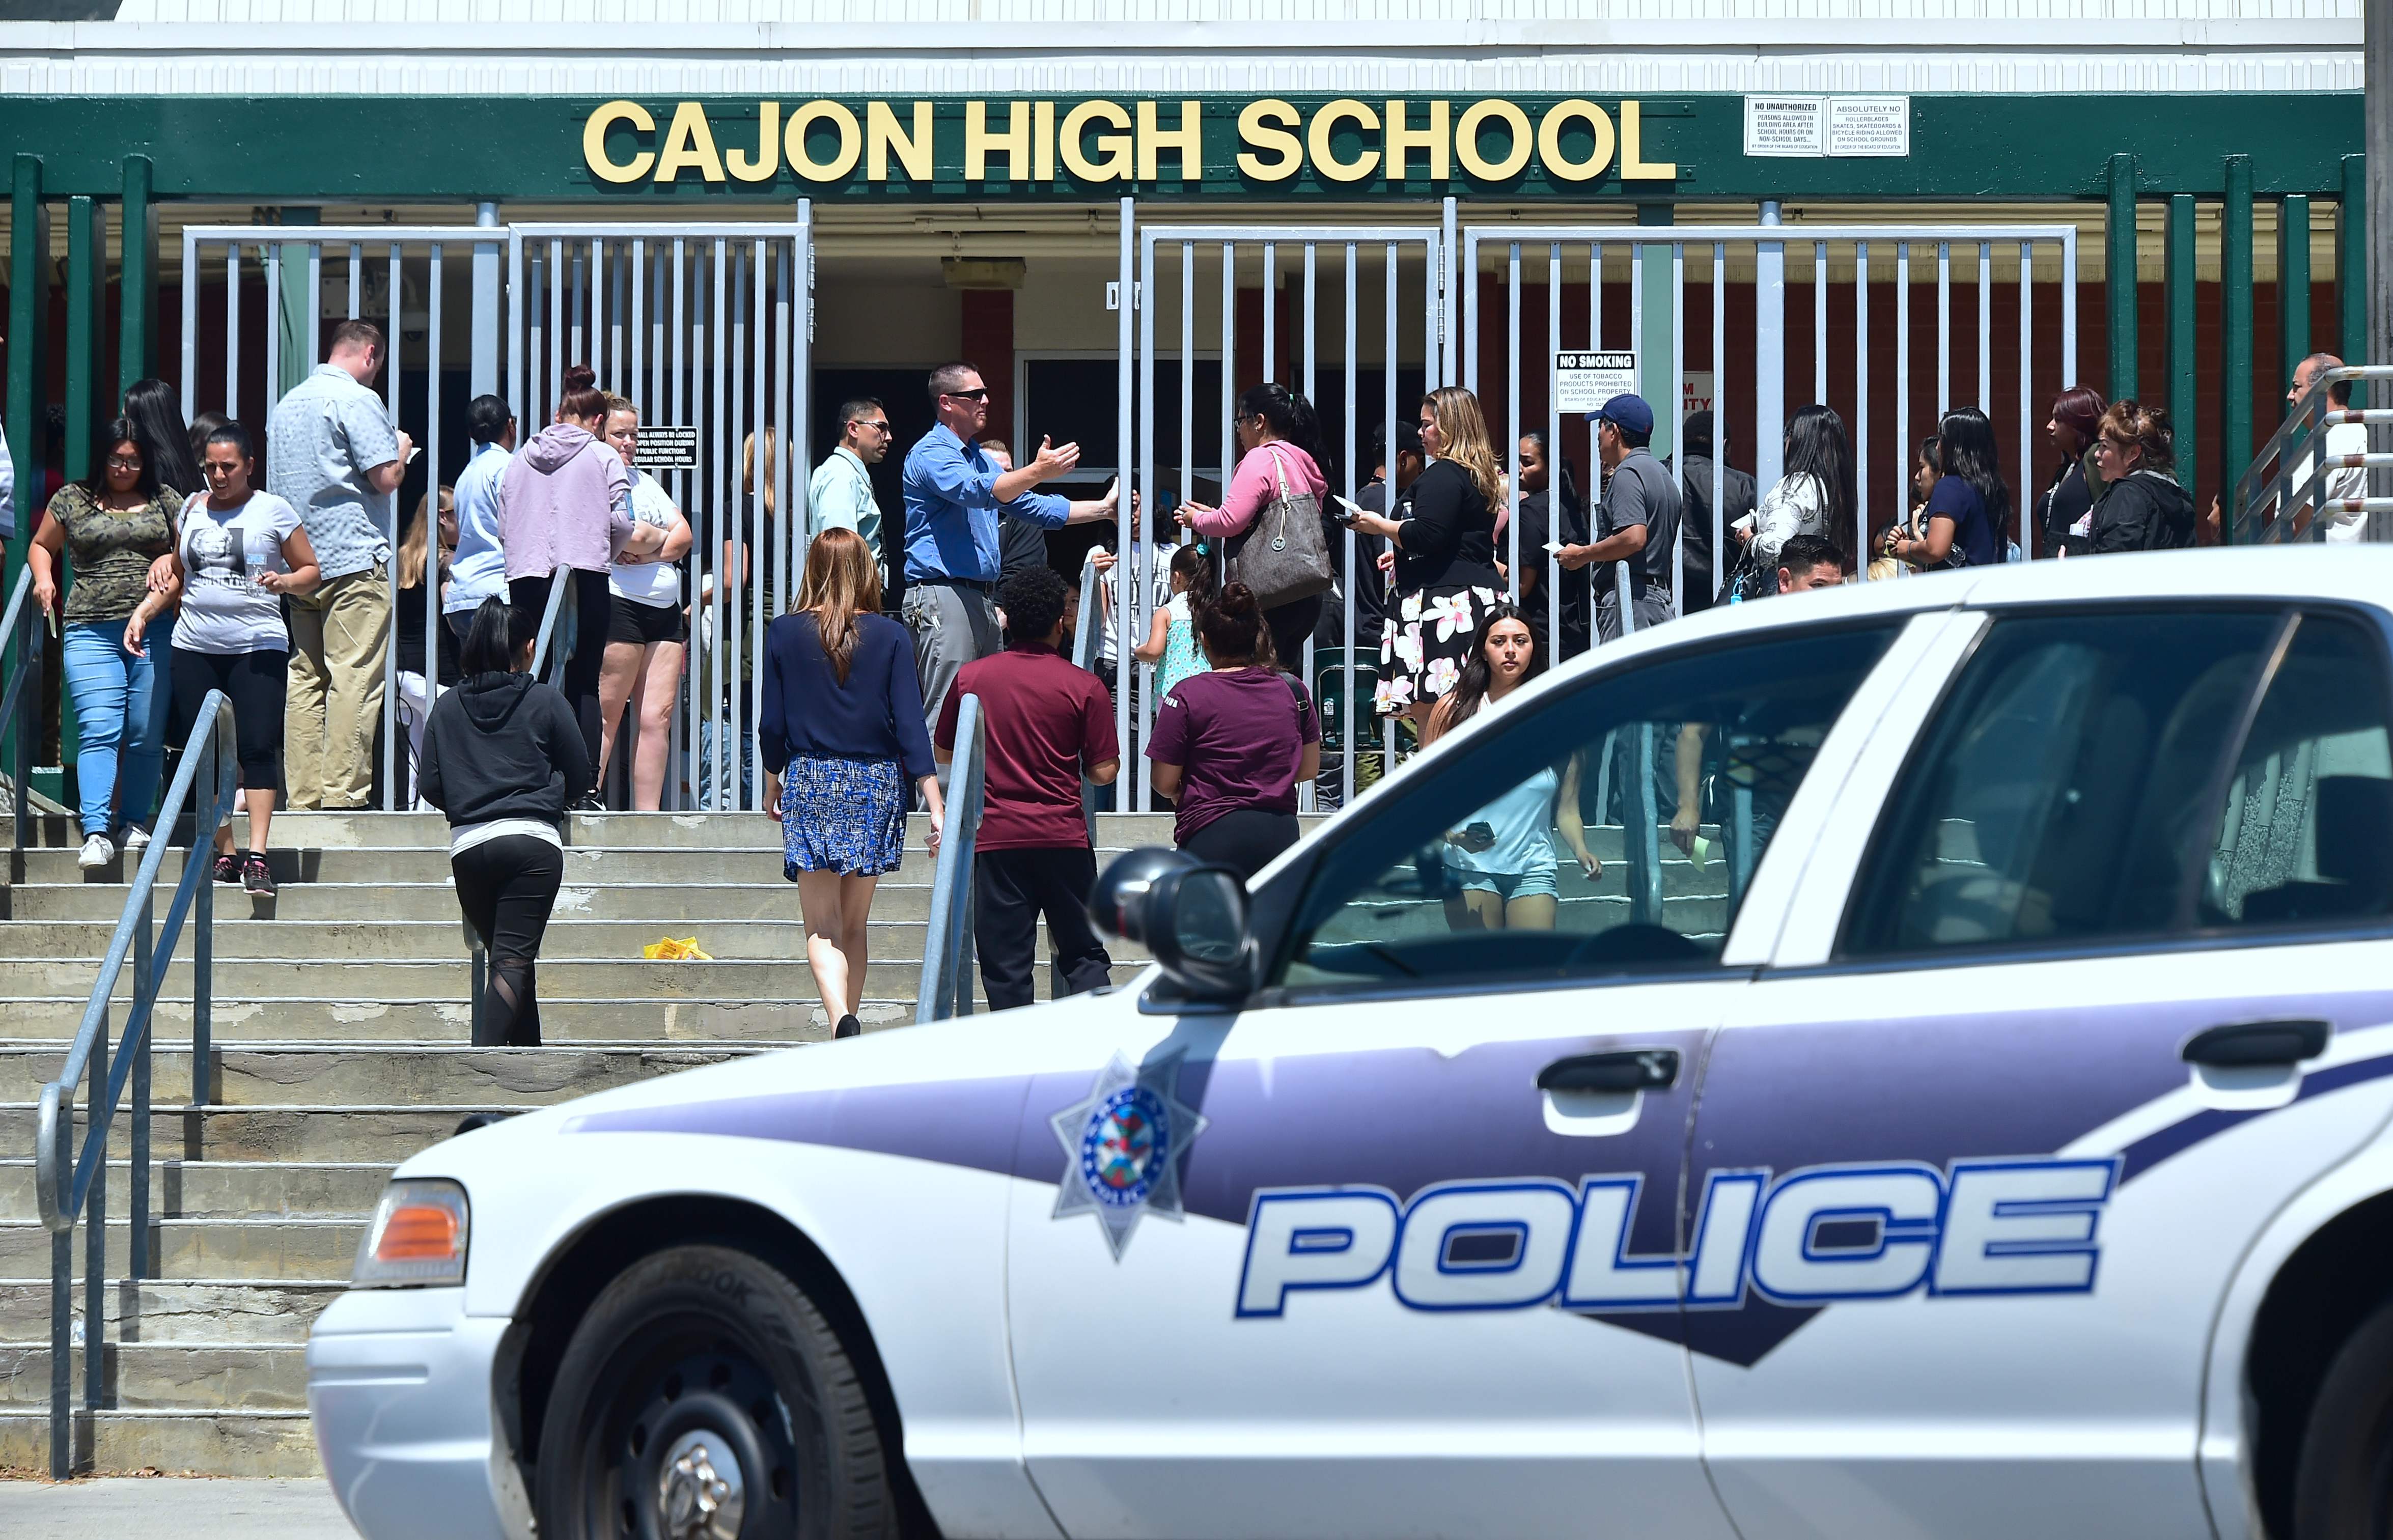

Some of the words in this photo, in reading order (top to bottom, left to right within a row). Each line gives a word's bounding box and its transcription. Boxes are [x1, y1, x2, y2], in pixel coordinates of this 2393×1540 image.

[583, 100, 933, 182] CAJON
[965, 100, 1201, 181] HIGH
[1237, 99, 1676, 181] SCHOOL
[1560, 355, 1576, 368] NO
[1579, 355, 1632, 368] SMOKING
[1234, 1155, 2123, 1319] POLICE
